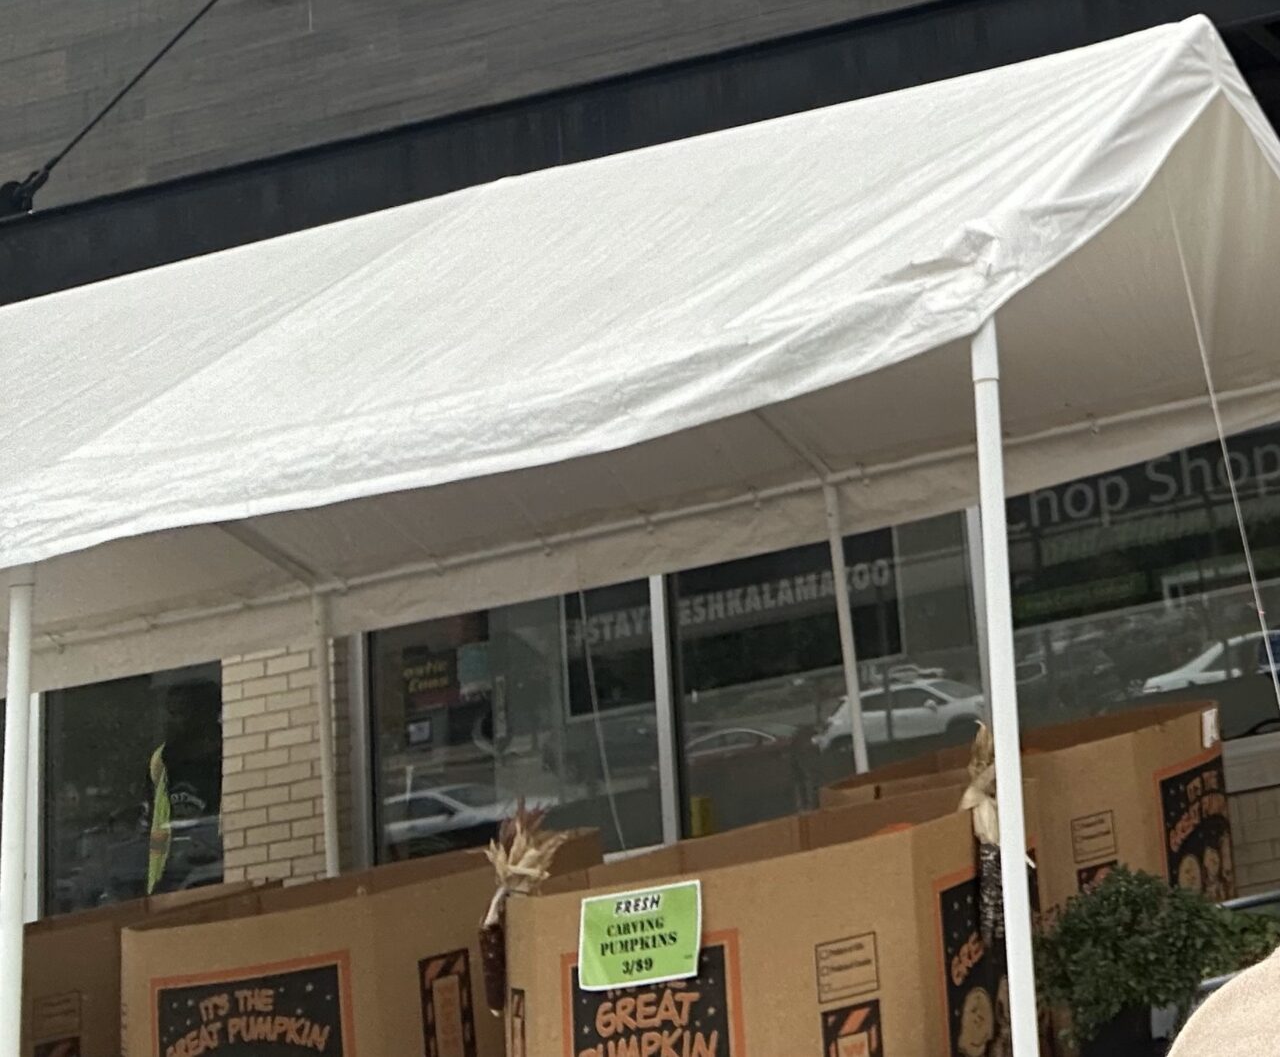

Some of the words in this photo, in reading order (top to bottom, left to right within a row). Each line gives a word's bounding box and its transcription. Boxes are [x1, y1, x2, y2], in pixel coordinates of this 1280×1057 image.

[1007, 474, 1130, 531] hop
[615, 894, 661, 914] FRESH
[606, 916, 665, 937] CARVING
[600, 932, 678, 956] PUMPKINS
[234, 988, 275, 1013] THE
[595, 988, 700, 1038] GREAT
[227, 1015, 331, 1052] PUMPKIN
